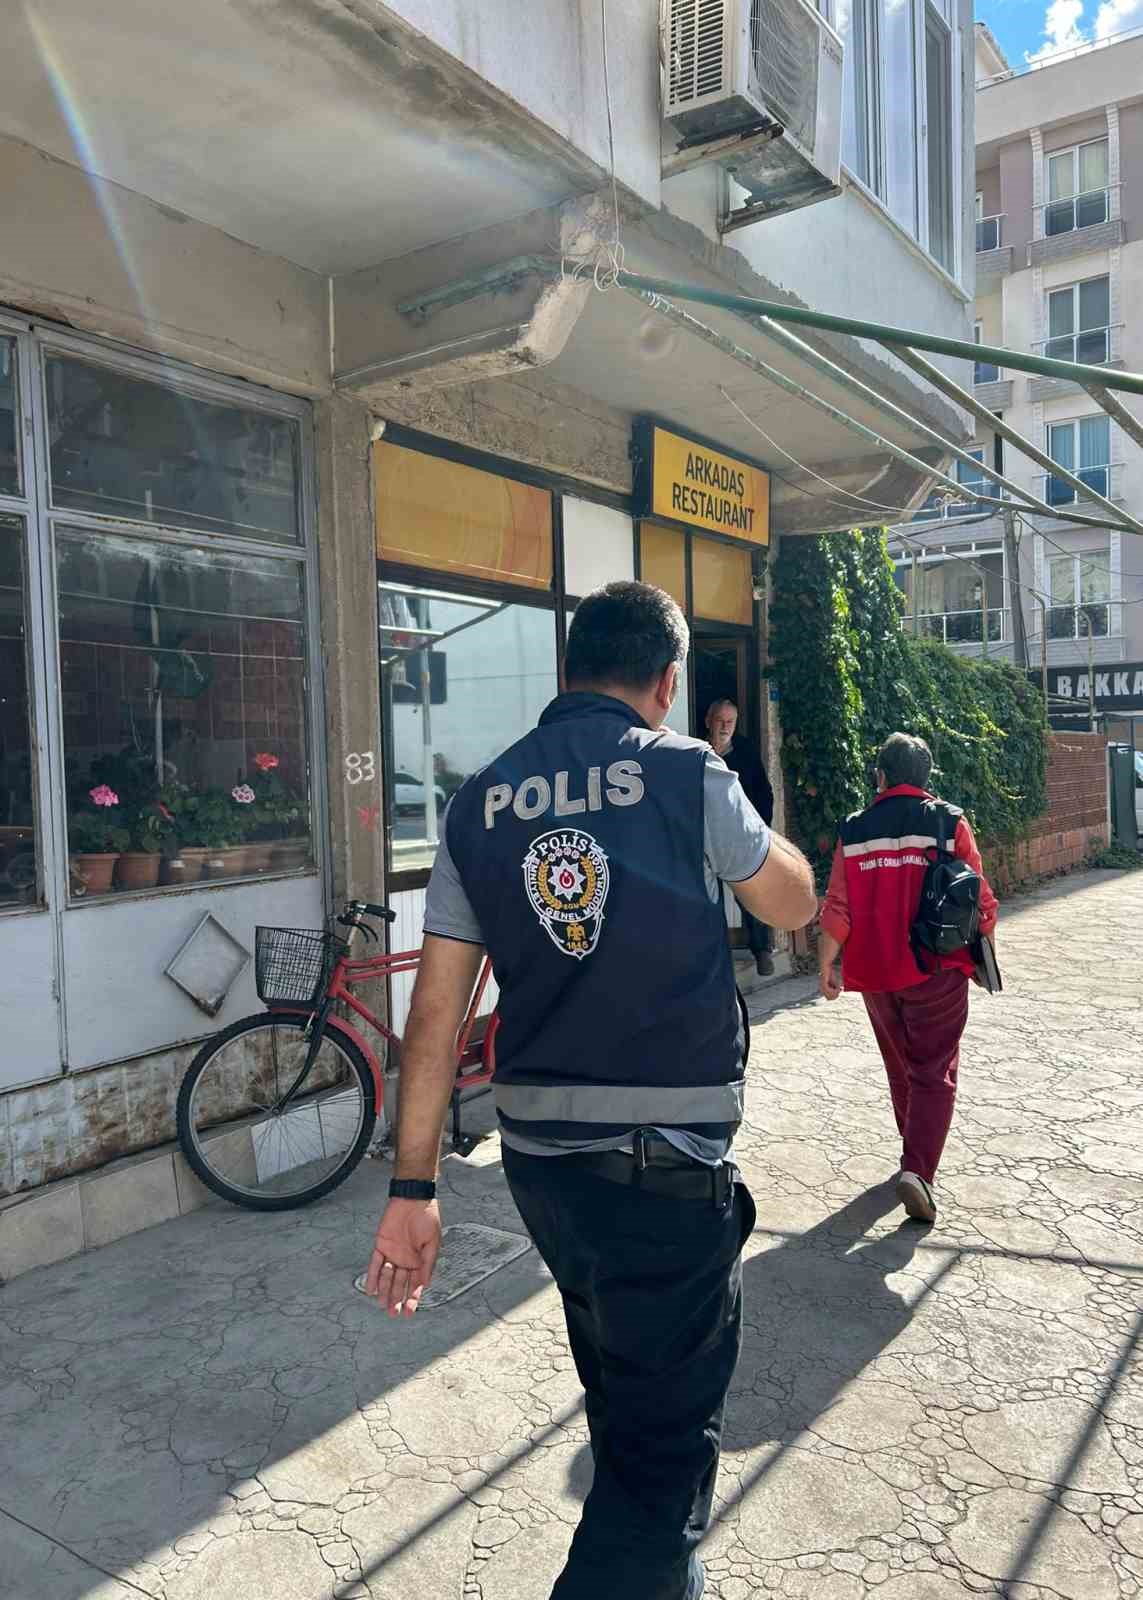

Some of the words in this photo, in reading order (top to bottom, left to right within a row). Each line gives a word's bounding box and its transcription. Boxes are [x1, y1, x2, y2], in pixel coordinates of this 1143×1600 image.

[685, 452, 745, 504] ARKADAŞ
[672, 482, 755, 532] RESTAURANT
[346, 752, 375, 784] 83
[484, 760, 645, 830] POLIS
[537, 832, 588, 856] POLİS
[545, 908, 582, 920] GENEL
